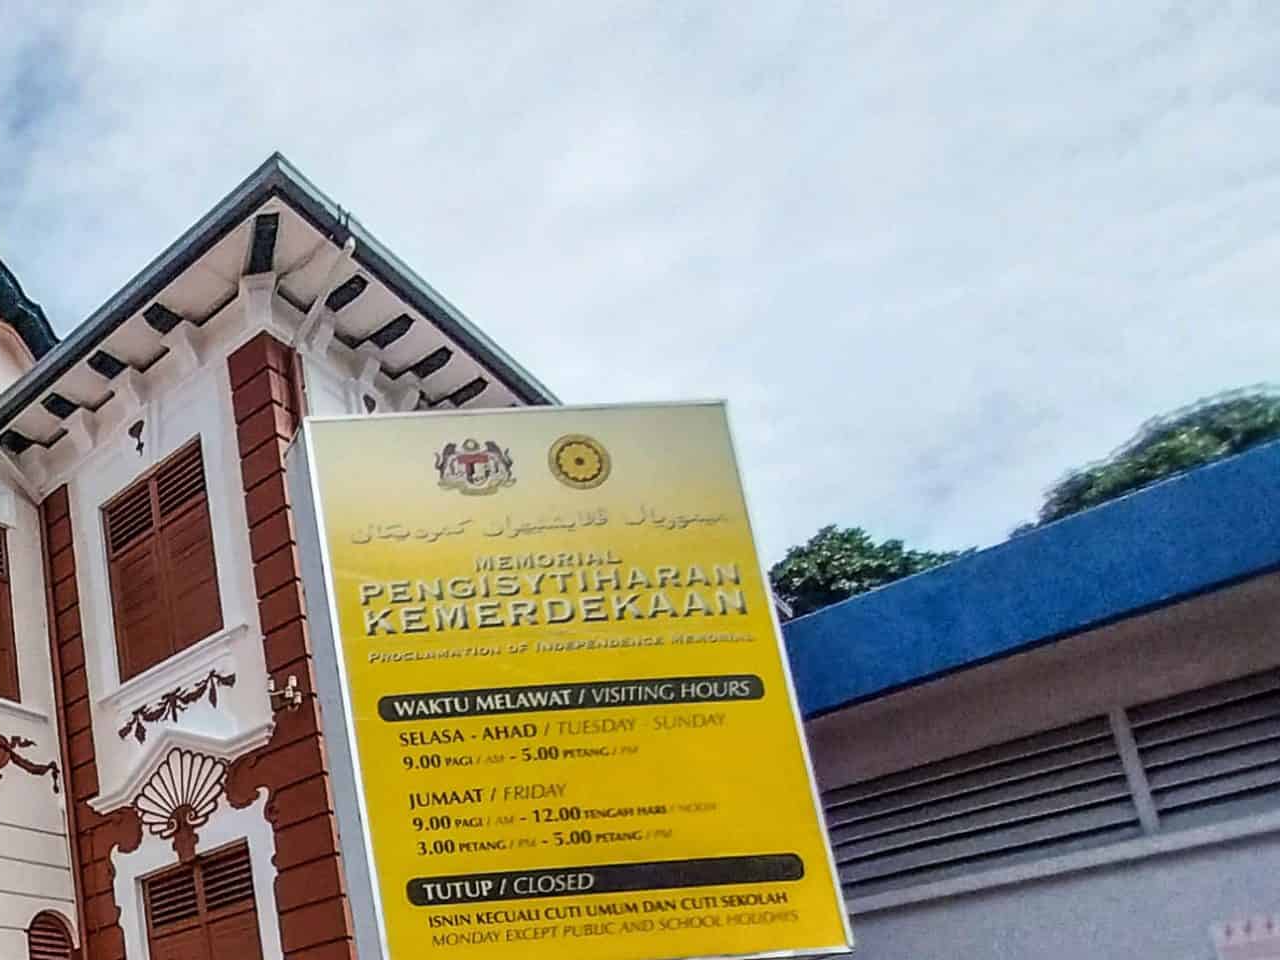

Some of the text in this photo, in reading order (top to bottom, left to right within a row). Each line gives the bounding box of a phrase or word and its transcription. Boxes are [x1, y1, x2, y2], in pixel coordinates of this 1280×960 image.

[475, 549, 622, 573] MEMORIAL
[359, 563, 741, 606] PENGISYTIHARAN
[364, 589, 748, 636] KEMERDEKAAN
[368, 646, 501, 664] PROCLAMATION
[536, 635, 664, 652] INDEPENDENCE
[393, 680, 751, 717] WAKTU MELAWAT / VISITING HOURS
[399, 729, 465, 747] SELASA
[482, 723, 537, 741] AHAD
[543, 722, 551, 736] /
[557, 716, 637, 735] TUESDAY
[653, 713, 726, 730] SUNDAY
[403, 754, 441, 770] 9.00
[445, 755, 473, 767] PAGI
[521, 746, 559, 761] 5.00
[563, 746, 609, 759] PETANG
[409, 783, 567, 810] JUMAAT / FRIDAY
[412, 815, 451, 831] 9.00
[455, 816, 483, 828] PAGI
[532, 806, 581, 823] 12.00
[417, 839, 455, 856] 3.00
[459, 840, 506, 852] PETANG
[553, 830, 592, 846] 5.00
[595, 831, 642, 843] PETANG
[422, 873, 595, 900] TUTUP / CLOSED
[428, 892, 788, 928] ISNIN KECUALI CUTI UMUM DAN CUTI SEKOLAH
[432, 929, 501, 947] MONDAY
[505, 925, 558, 942] EXCEPT
[563, 921, 615, 937] PUBLIC
[620, 919, 654, 933] AND
[658, 915, 723, 931] SCHOOL
